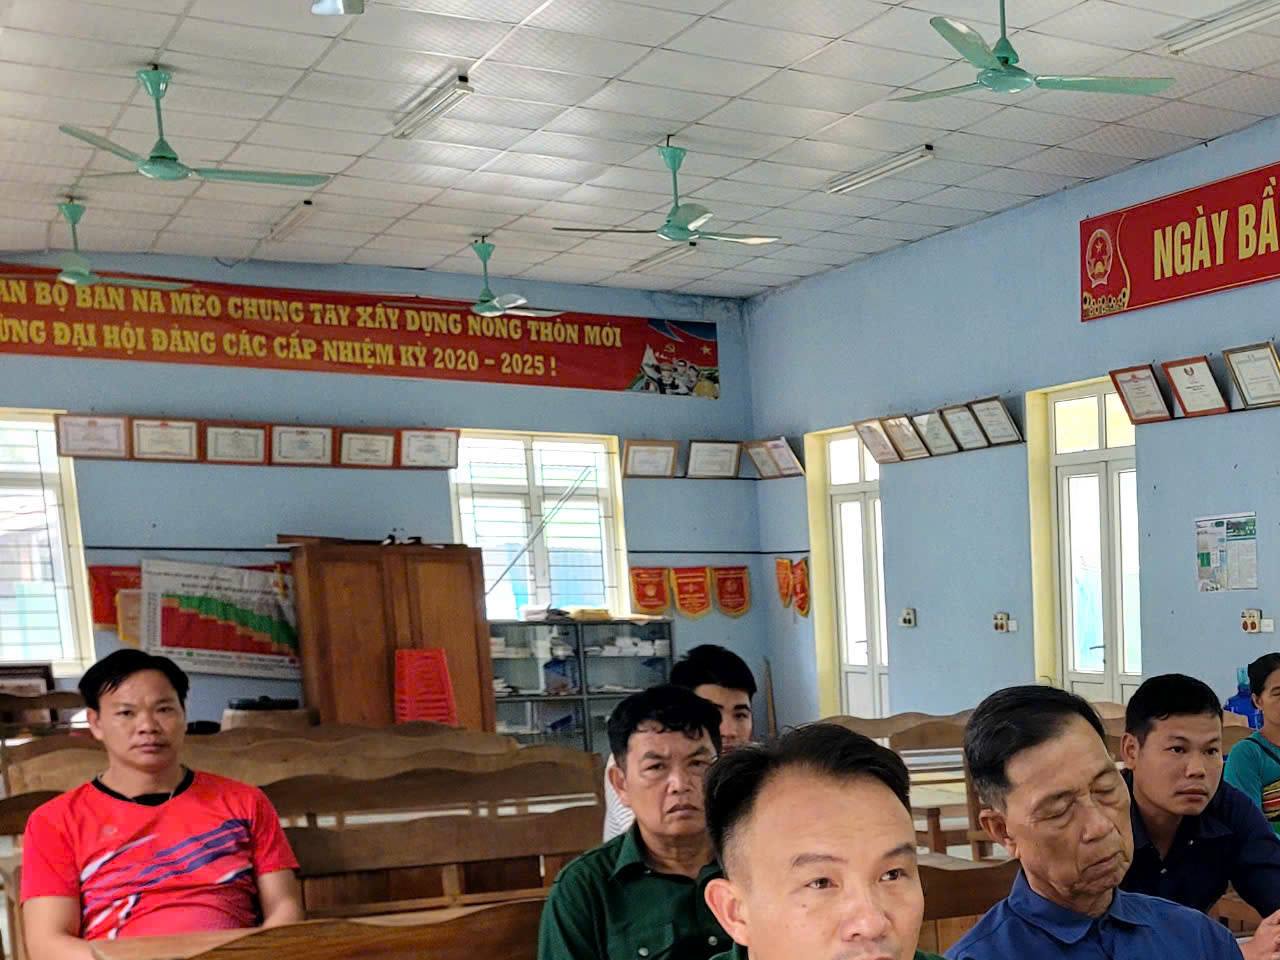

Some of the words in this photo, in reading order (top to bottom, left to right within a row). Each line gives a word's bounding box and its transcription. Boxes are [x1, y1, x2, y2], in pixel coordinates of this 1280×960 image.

[1154, 209, 1229, 281] NGÀY
[131, 288, 166, 313] NA
[227, 296, 305, 324] CHUNG
[310, 303, 351, 326] TAY
[356, 303, 400, 330] XÂY
[52, 321, 98, 353] ĐẠI
[103, 321, 147, 356] HỘI
[222, 330, 268, 359] CÁC
[273, 329, 318, 361] CẤP
[322, 338, 395, 369] NHIỆM
[433, 347, 479, 371] 2020
[500, 352, 545, 375] 2025
[550, 356, 557, 377] !
